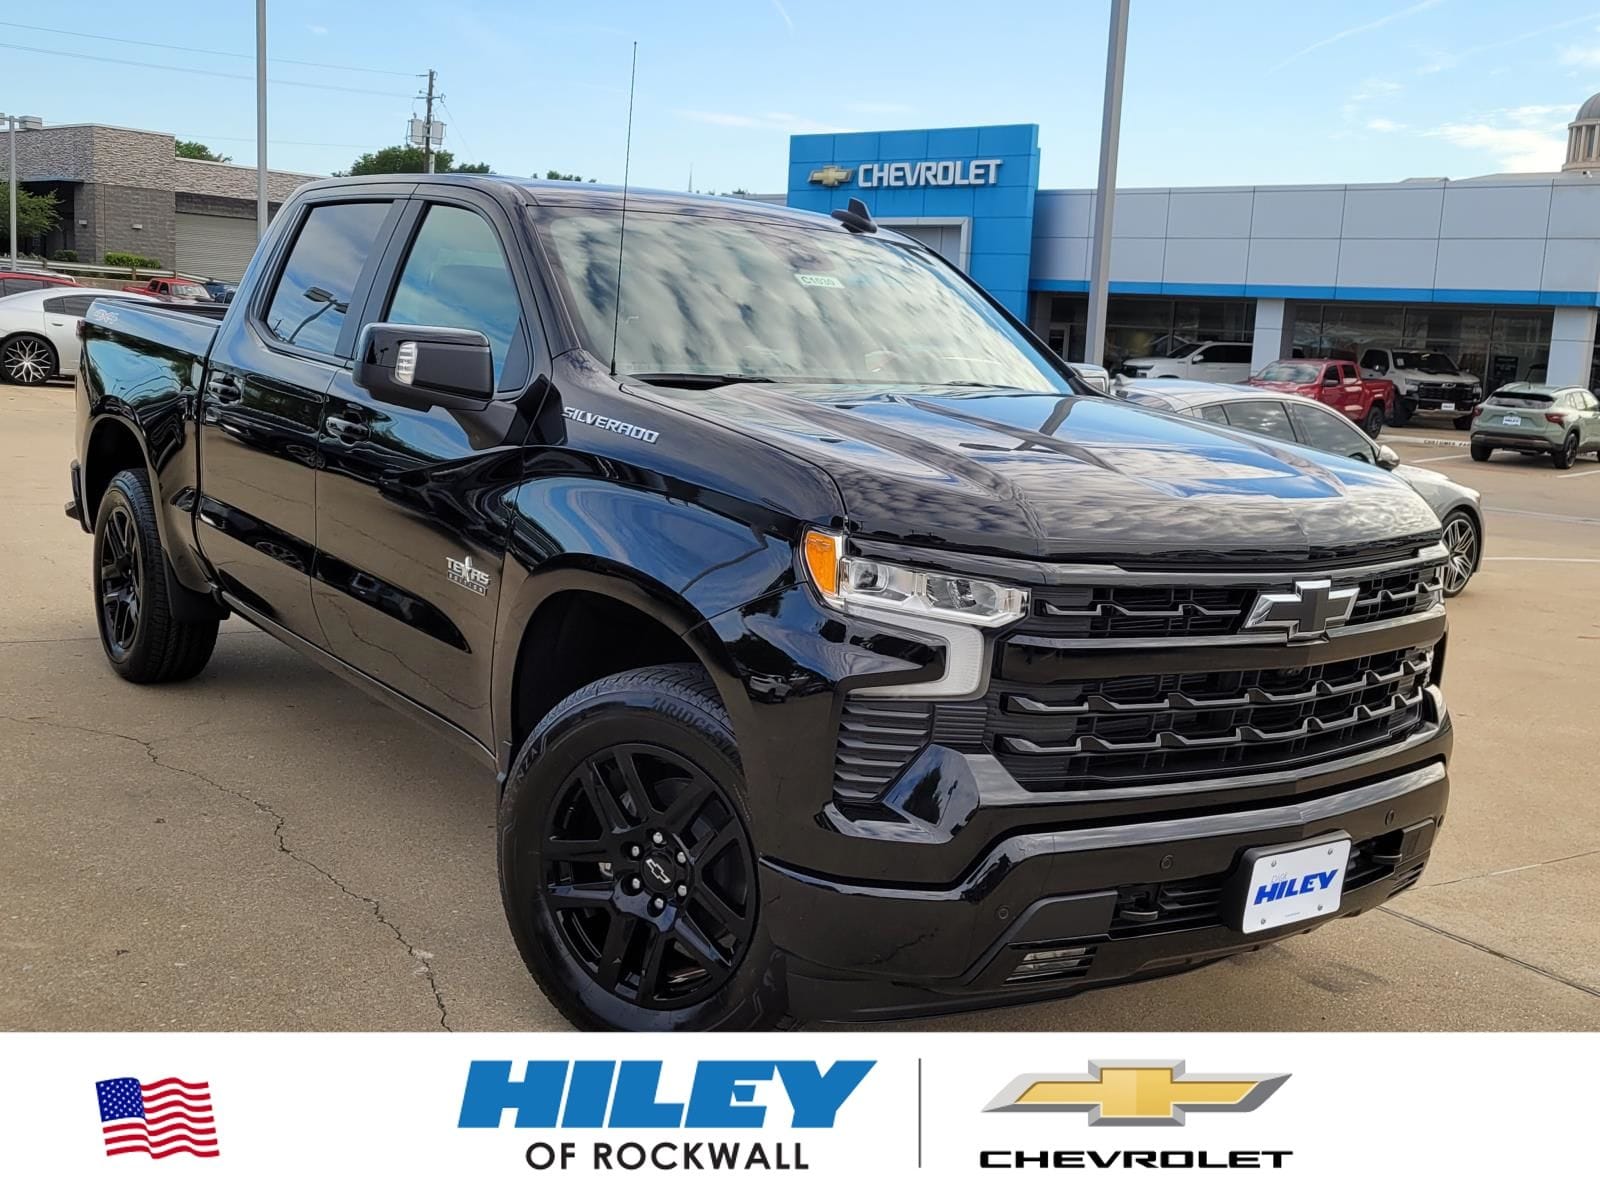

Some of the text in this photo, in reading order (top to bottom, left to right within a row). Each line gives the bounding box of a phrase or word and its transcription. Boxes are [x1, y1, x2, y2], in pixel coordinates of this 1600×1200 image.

[858, 160, 1001, 188] CHEVROLET
[561, 406, 659, 443] SILVERADO
[446, 556, 489, 585] TEXAS
[1253, 868, 1339, 906] HILEY
